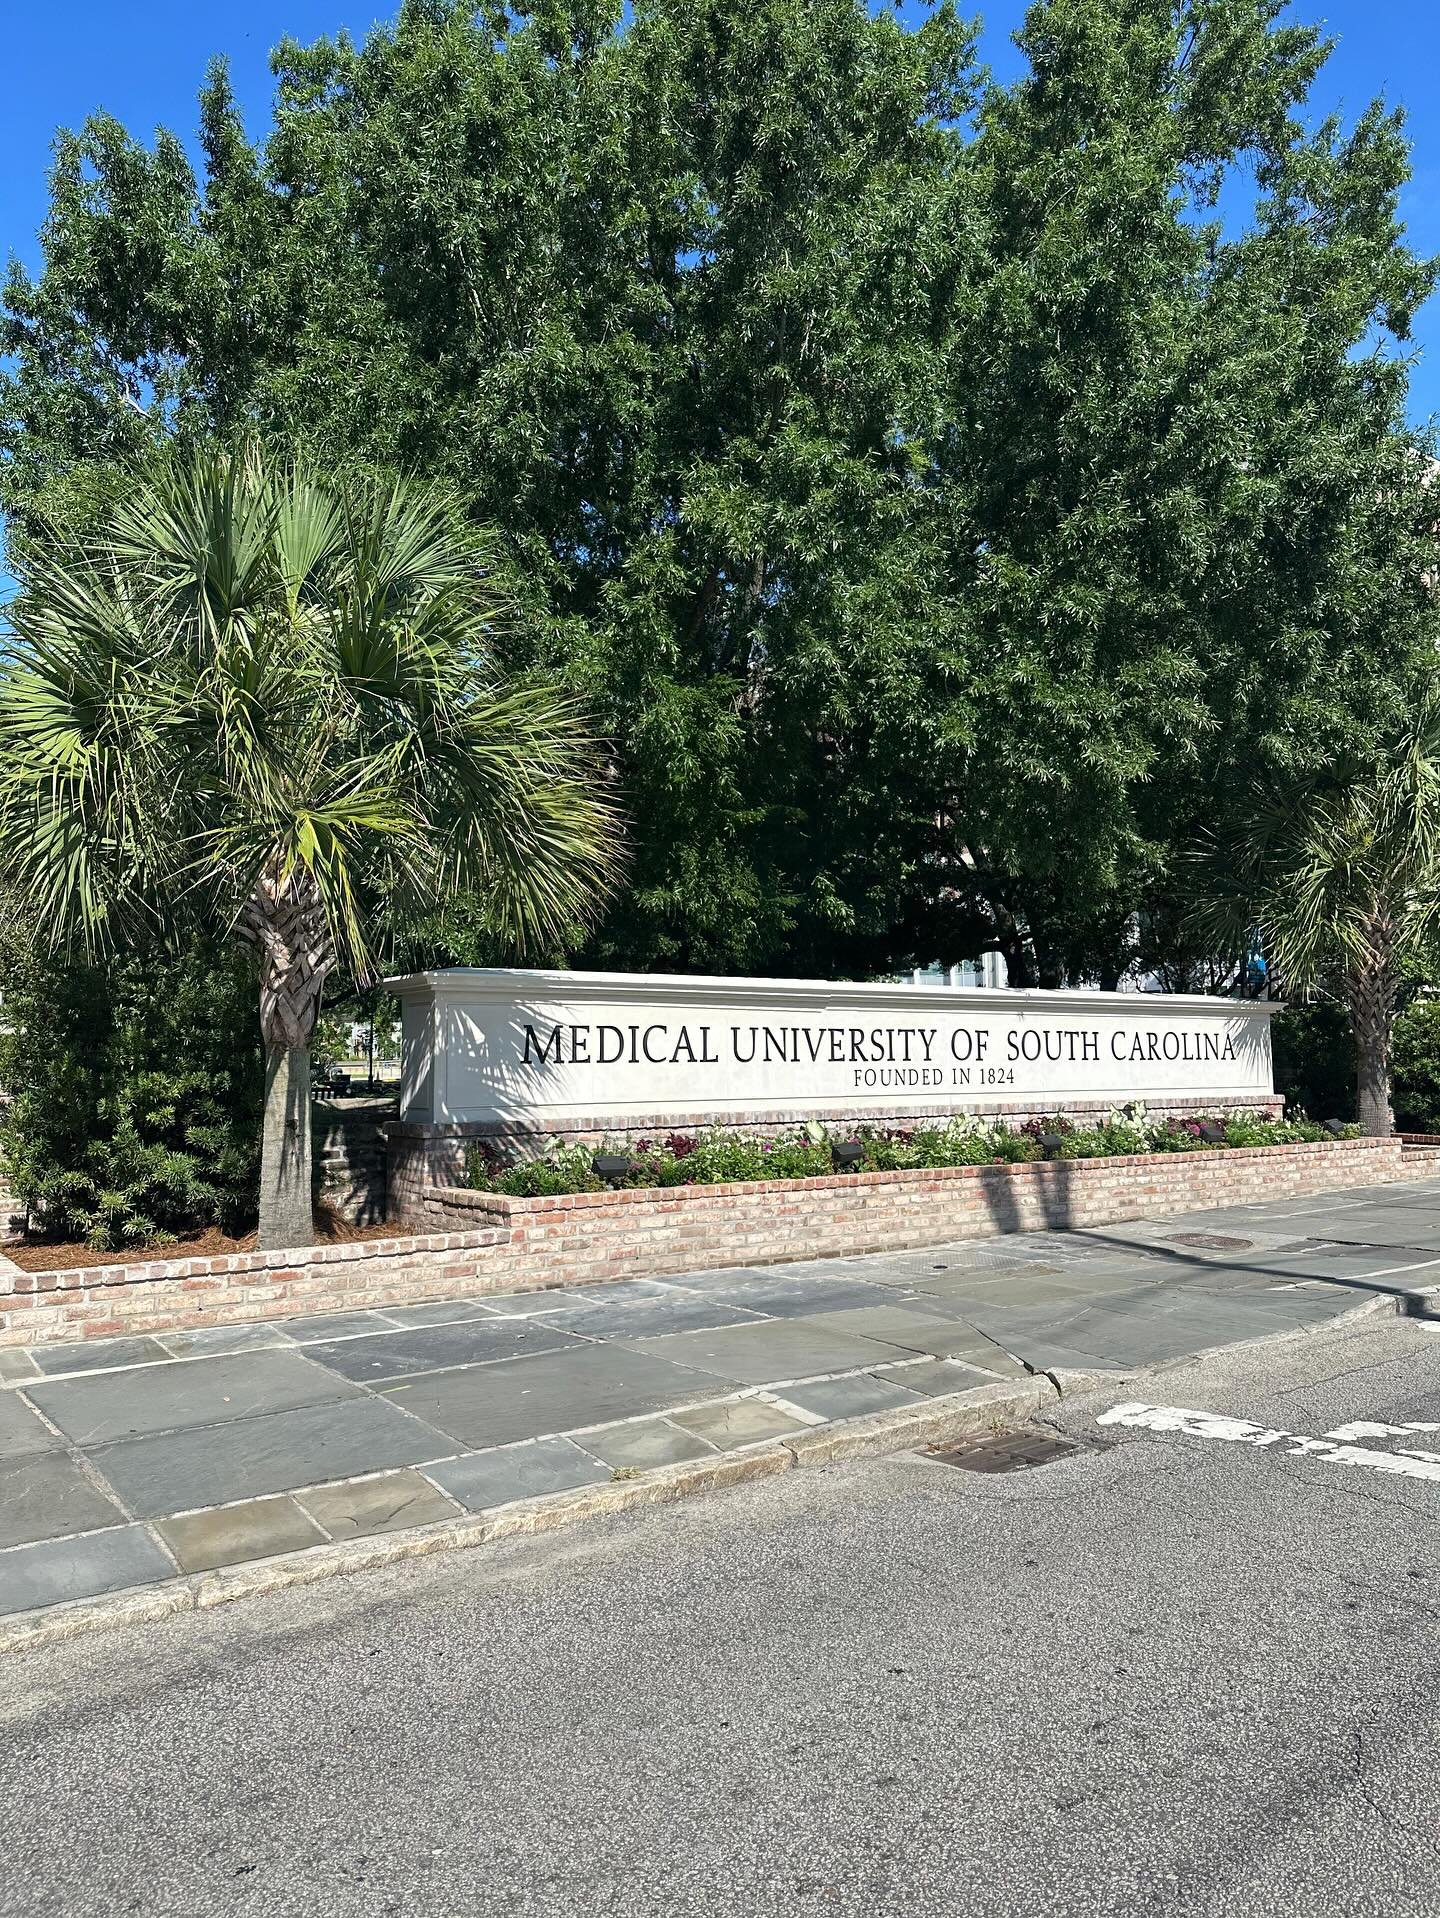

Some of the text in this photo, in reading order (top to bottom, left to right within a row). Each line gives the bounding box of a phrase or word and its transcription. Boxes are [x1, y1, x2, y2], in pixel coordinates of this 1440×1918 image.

[519, 1024, 1237, 1064] MEDICAL UNIVERSITY OF SOUTH CAROLINA
[854, 1067, 1015, 1087] FOUNDED IN 1824
